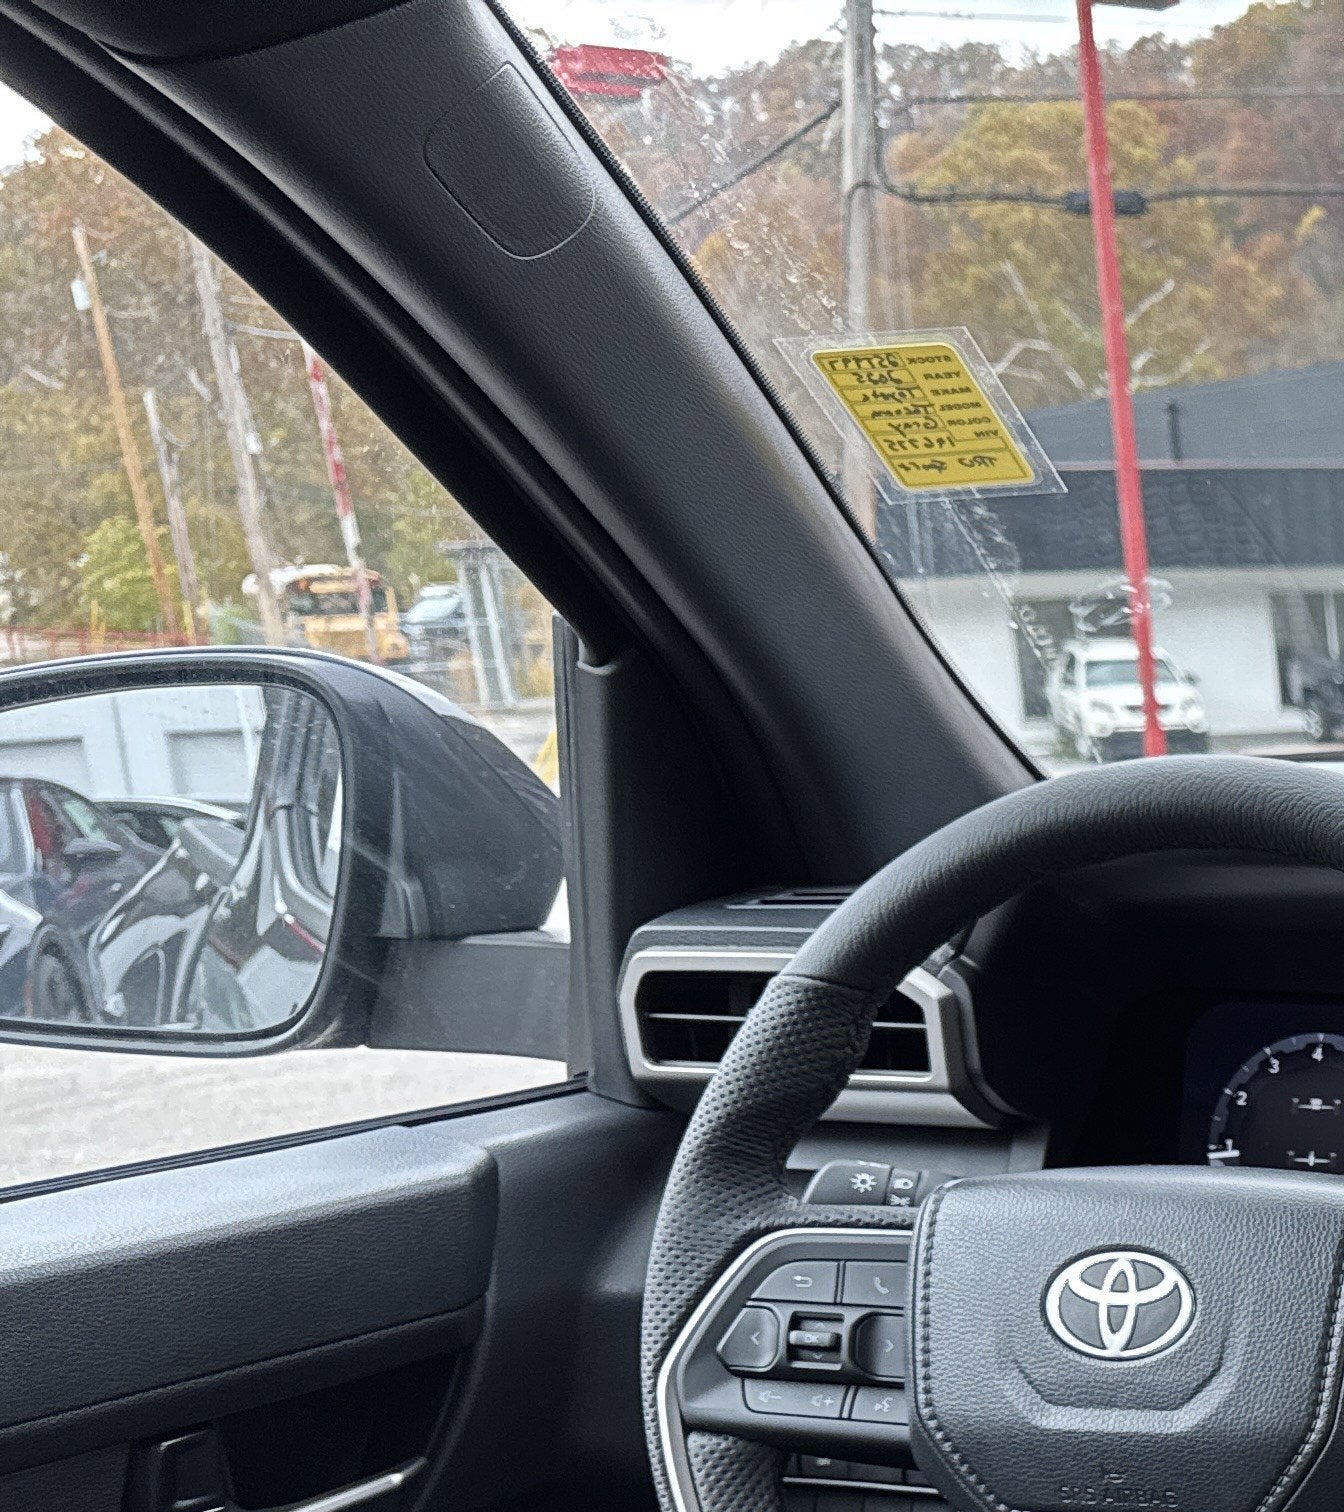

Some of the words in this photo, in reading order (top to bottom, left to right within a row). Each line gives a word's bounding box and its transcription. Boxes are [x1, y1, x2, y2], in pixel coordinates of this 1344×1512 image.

[1311, 1047, 1323, 1062] 4
[1269, 1058, 1281, 1075] 3
[1236, 1091, 1248, 1106] 2
